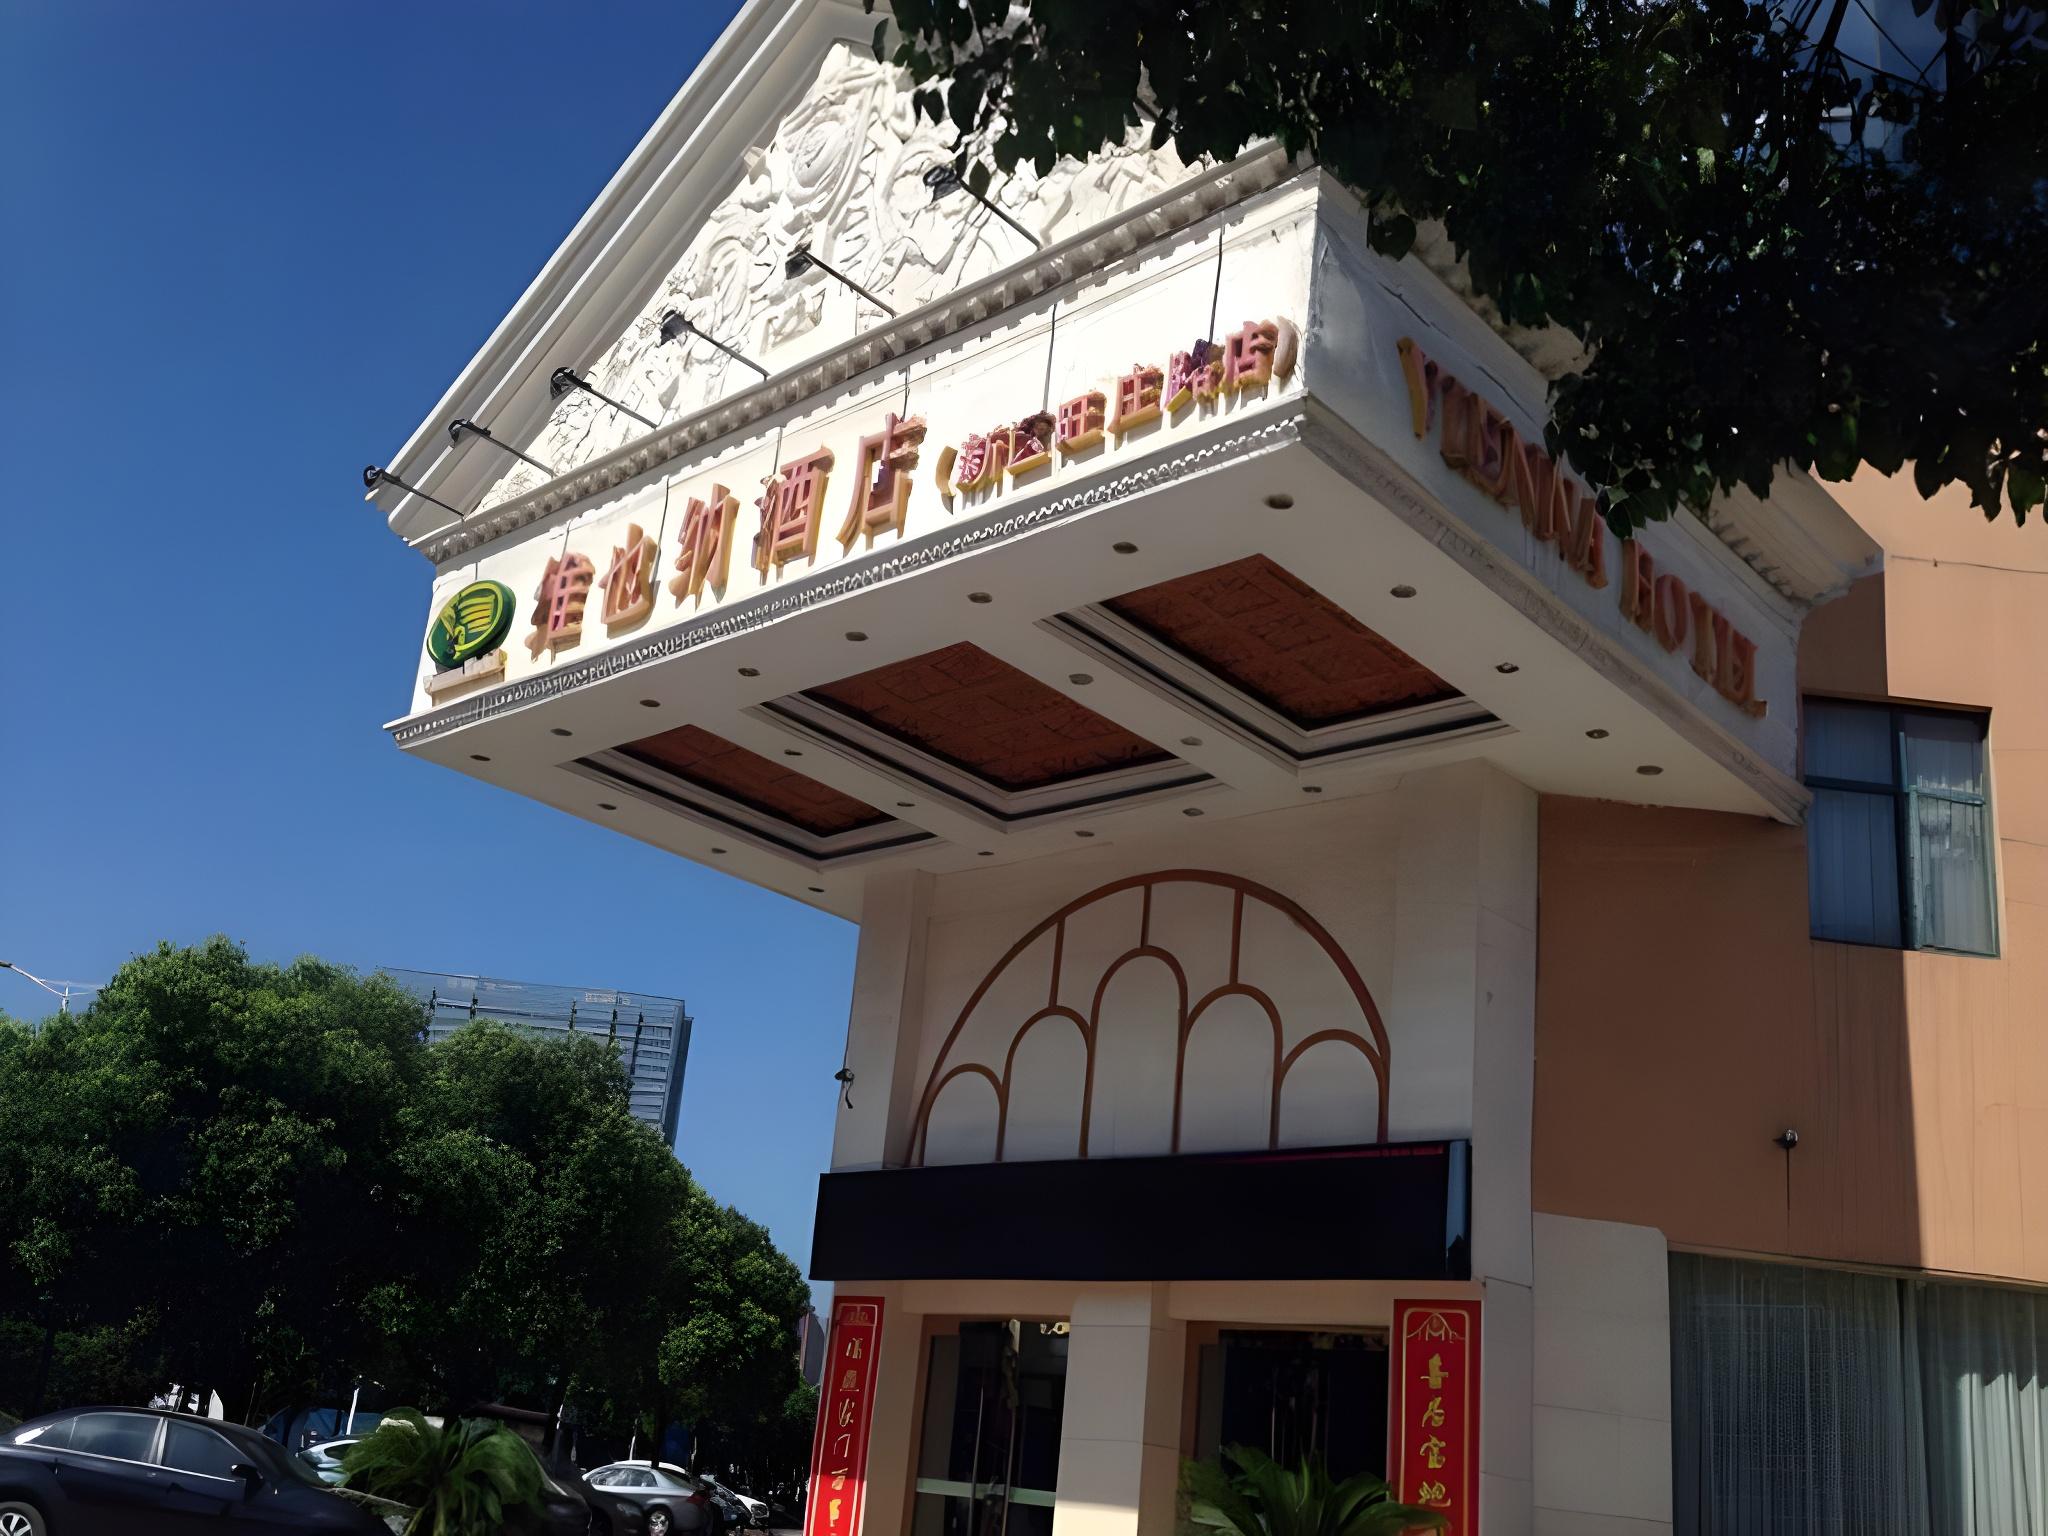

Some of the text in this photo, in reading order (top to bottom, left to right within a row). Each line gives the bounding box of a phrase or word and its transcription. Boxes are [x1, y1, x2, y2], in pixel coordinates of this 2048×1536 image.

[524, 412, 928, 664] 维也纳酒店
